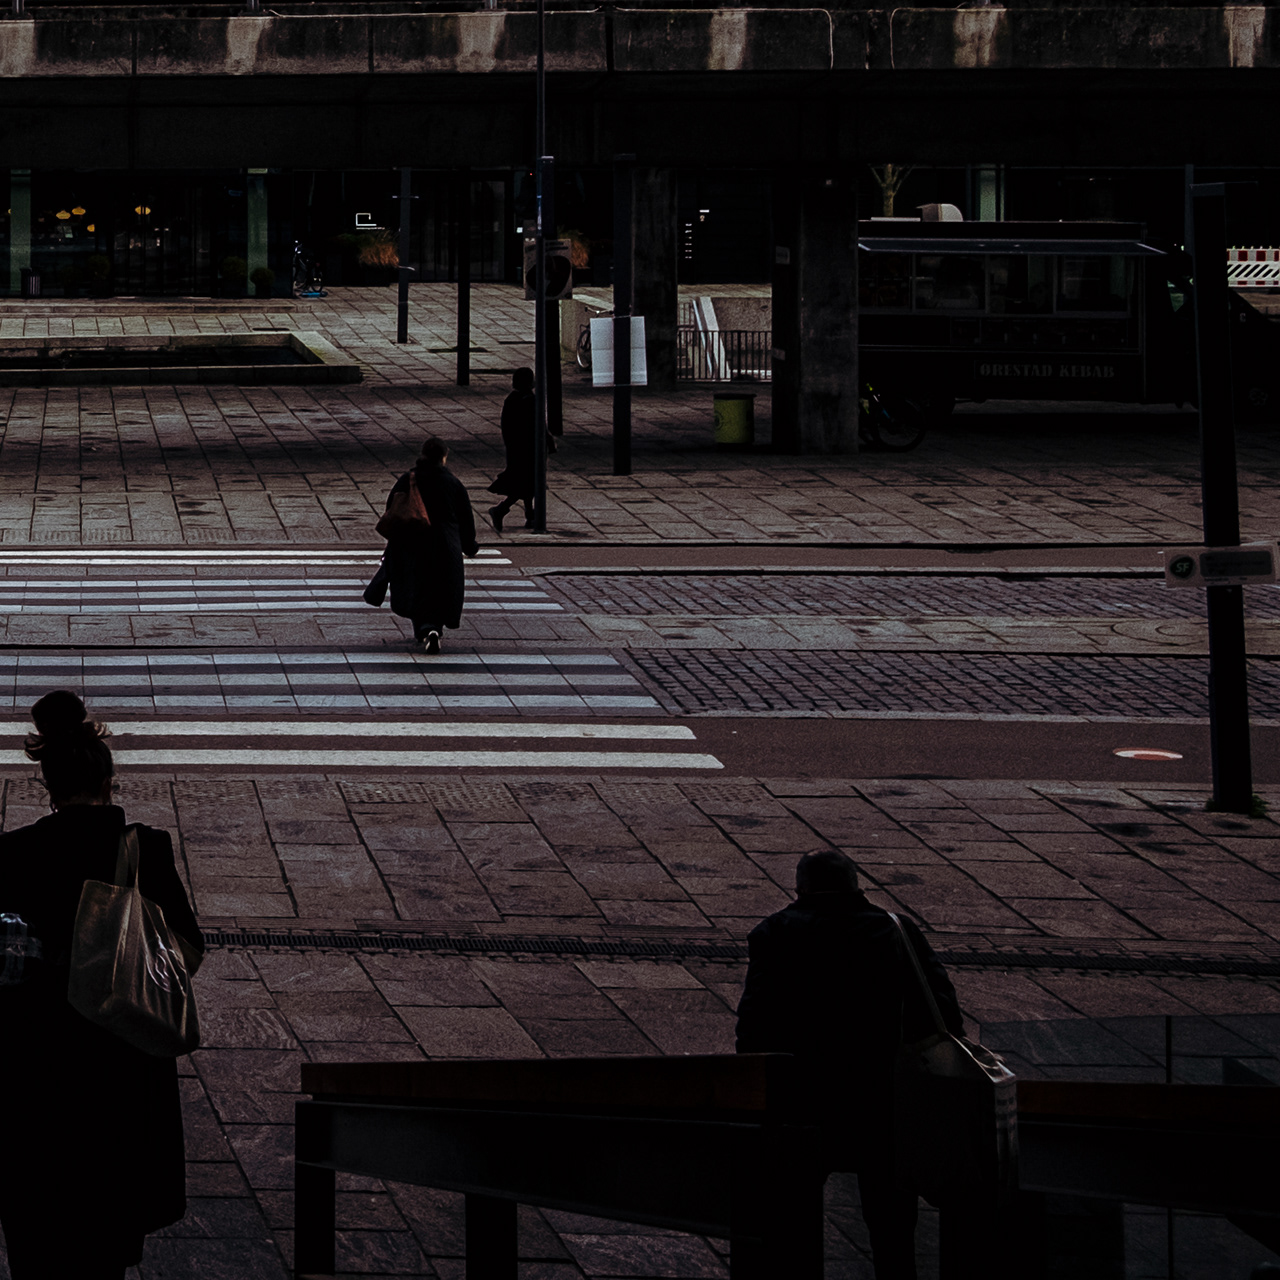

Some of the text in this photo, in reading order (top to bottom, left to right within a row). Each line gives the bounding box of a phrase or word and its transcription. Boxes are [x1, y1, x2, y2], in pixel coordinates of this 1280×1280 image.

[978, 362, 1116, 378] ØRESTAD KEBAB
[1175, 561, 1191, 573] SF
